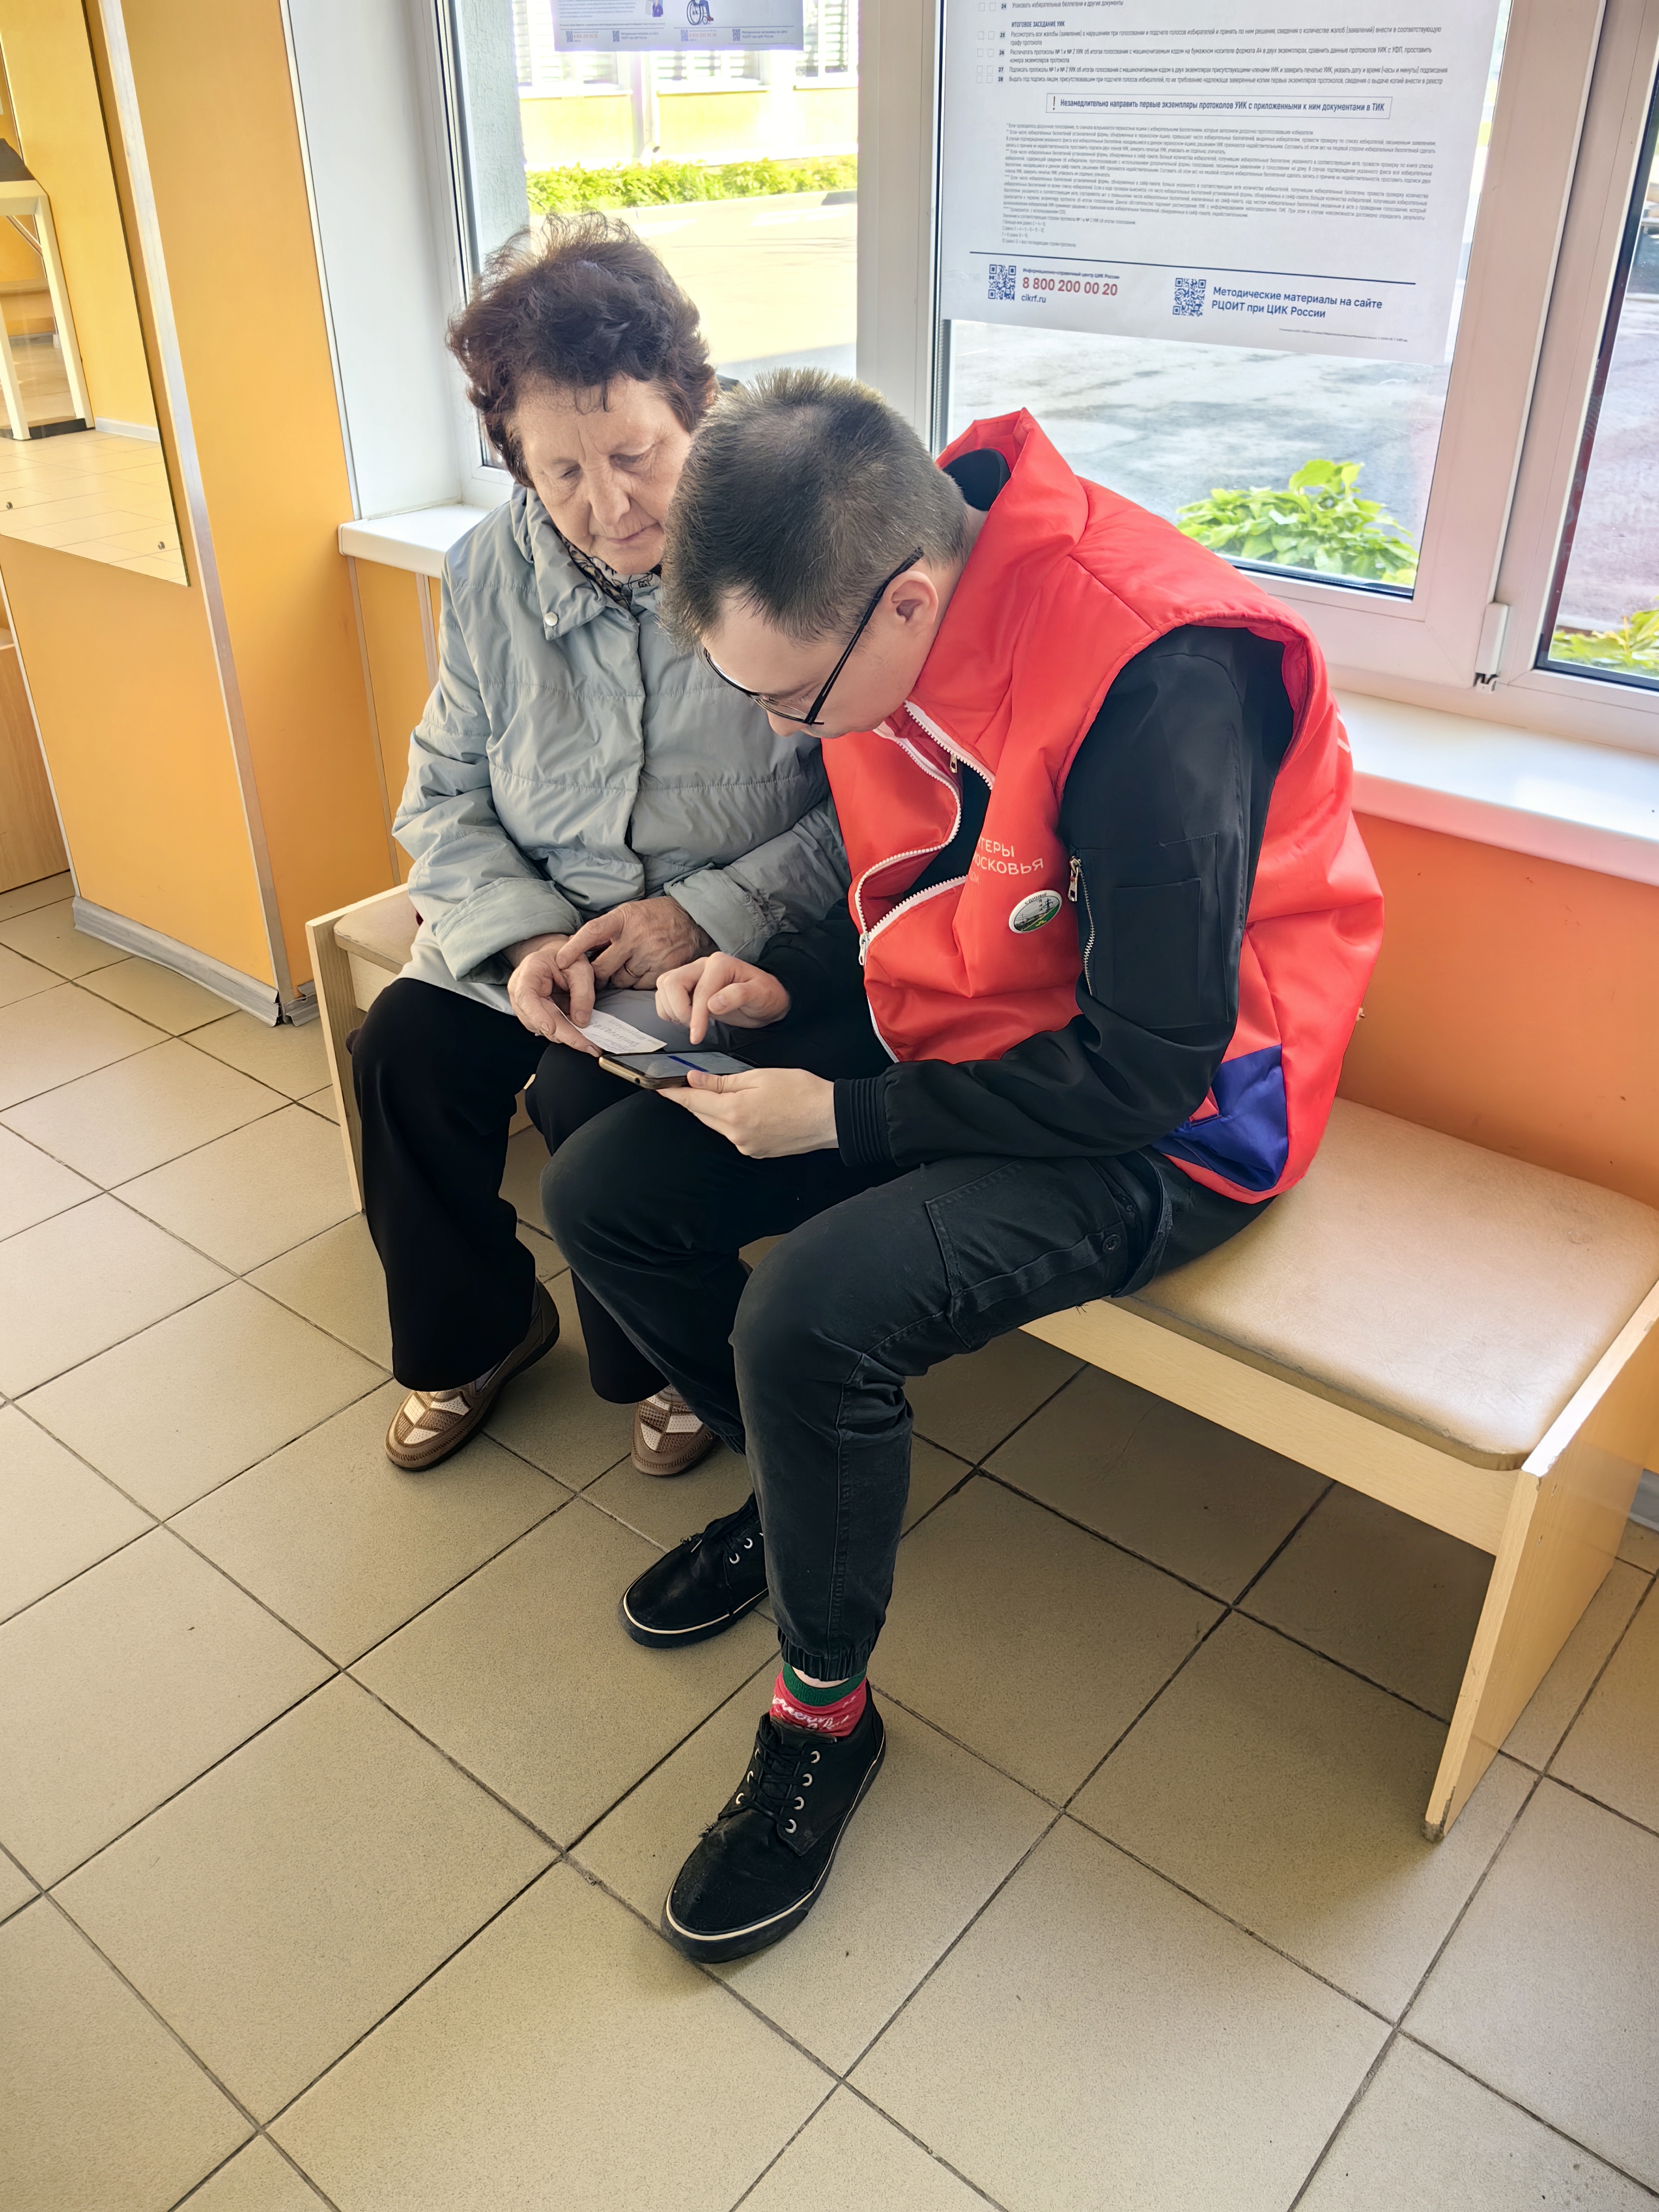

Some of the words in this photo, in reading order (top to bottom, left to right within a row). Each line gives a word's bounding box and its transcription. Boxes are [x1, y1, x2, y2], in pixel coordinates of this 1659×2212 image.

[1060, 98, 1109, 107] Незамедлительно
[1161, 101, 1198, 110] экземпляры
[1199, 102, 1234, 110] протоколов
[1234, 101, 1247, 109] УИК
[1321, 103, 1365, 112] документами
[1372, 102, 1385, 111] ТИК
[1022, 276, 1029, 289] 8
[1032, 277, 1055, 291] 800
[1057, 279, 1081, 293] 200
[1084, 281, 1099, 294] 00
[1102, 283, 1118, 296] 20
[1021, 295, 1046, 304] cikrf.ru
[1213, 286, 1281, 300] Методические
[1283, 293, 1337, 305] материалы
[1353, 299, 1383, 309] сайте
[1211, 299, 1245, 311] РЦОИТ
[1246, 304, 1264, 314] при
[1266, 304, 1288, 315] ЦИК
[1290, 306, 1326, 318] России
[978, 837, 1015, 857] ТЕРЫ
